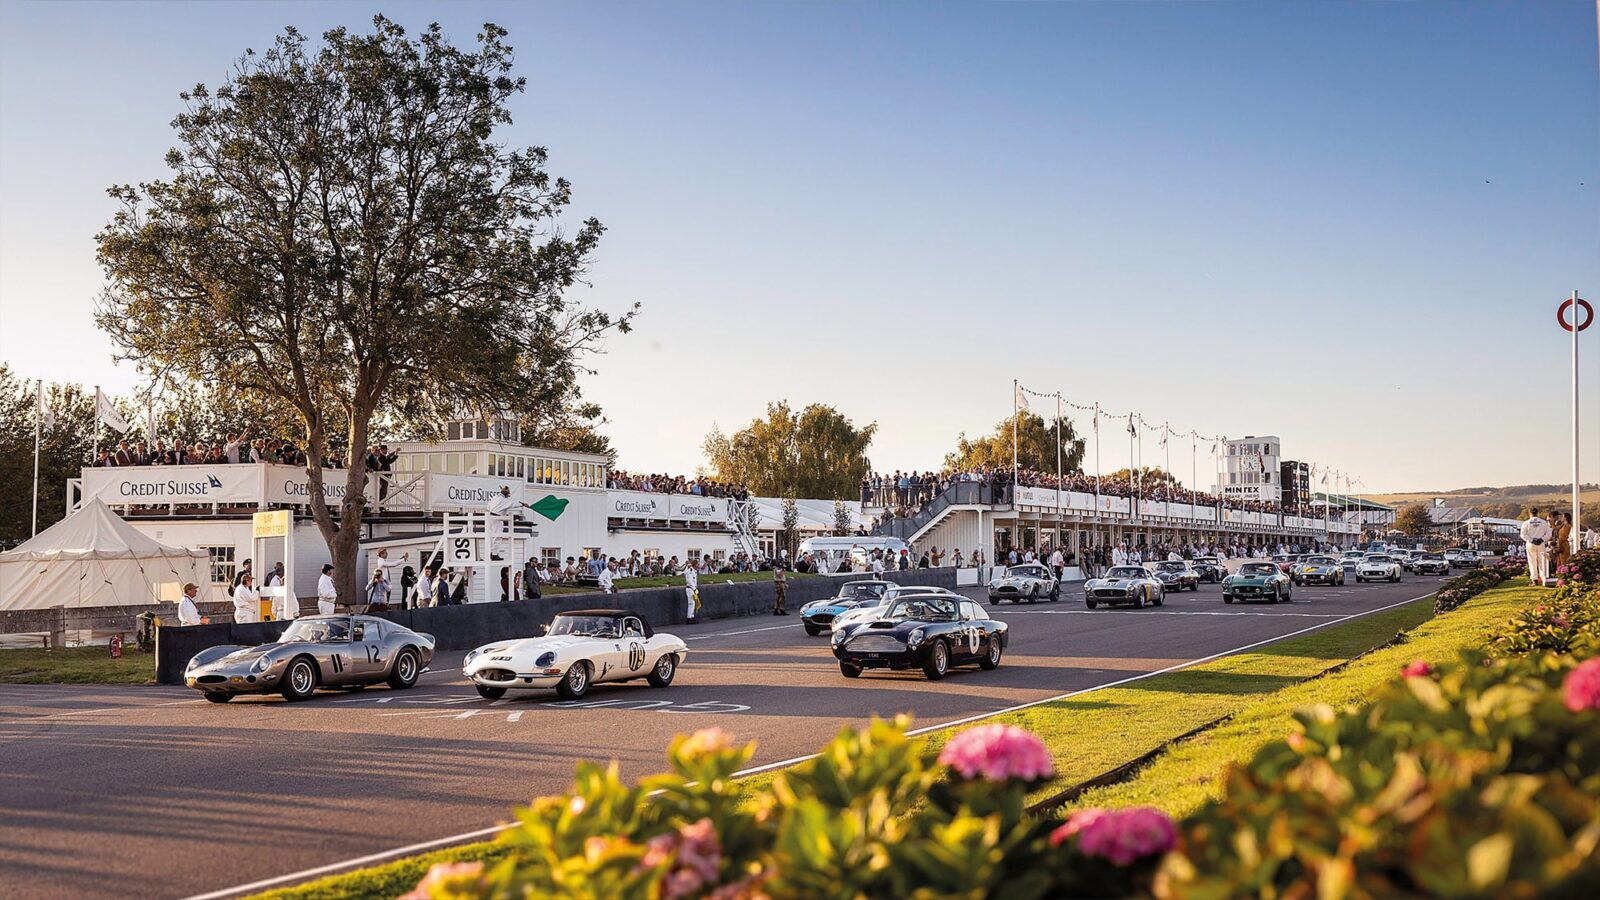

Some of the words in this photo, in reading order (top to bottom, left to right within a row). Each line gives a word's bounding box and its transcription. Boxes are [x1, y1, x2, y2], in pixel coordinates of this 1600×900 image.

[120, 481, 166, 496] CREDIT
[167, 480, 209, 495] SUISSE
[321, 482, 346, 498] SUISS
[448, 486, 476, 501] CREDIT
[615, 500, 635, 512] CREDIT
[635, 501, 652, 514] SUISSE
[680, 504, 697, 515] CREDIT
[697, 505, 712, 516] SUISSE
[364, 645, 381, 664] 12
